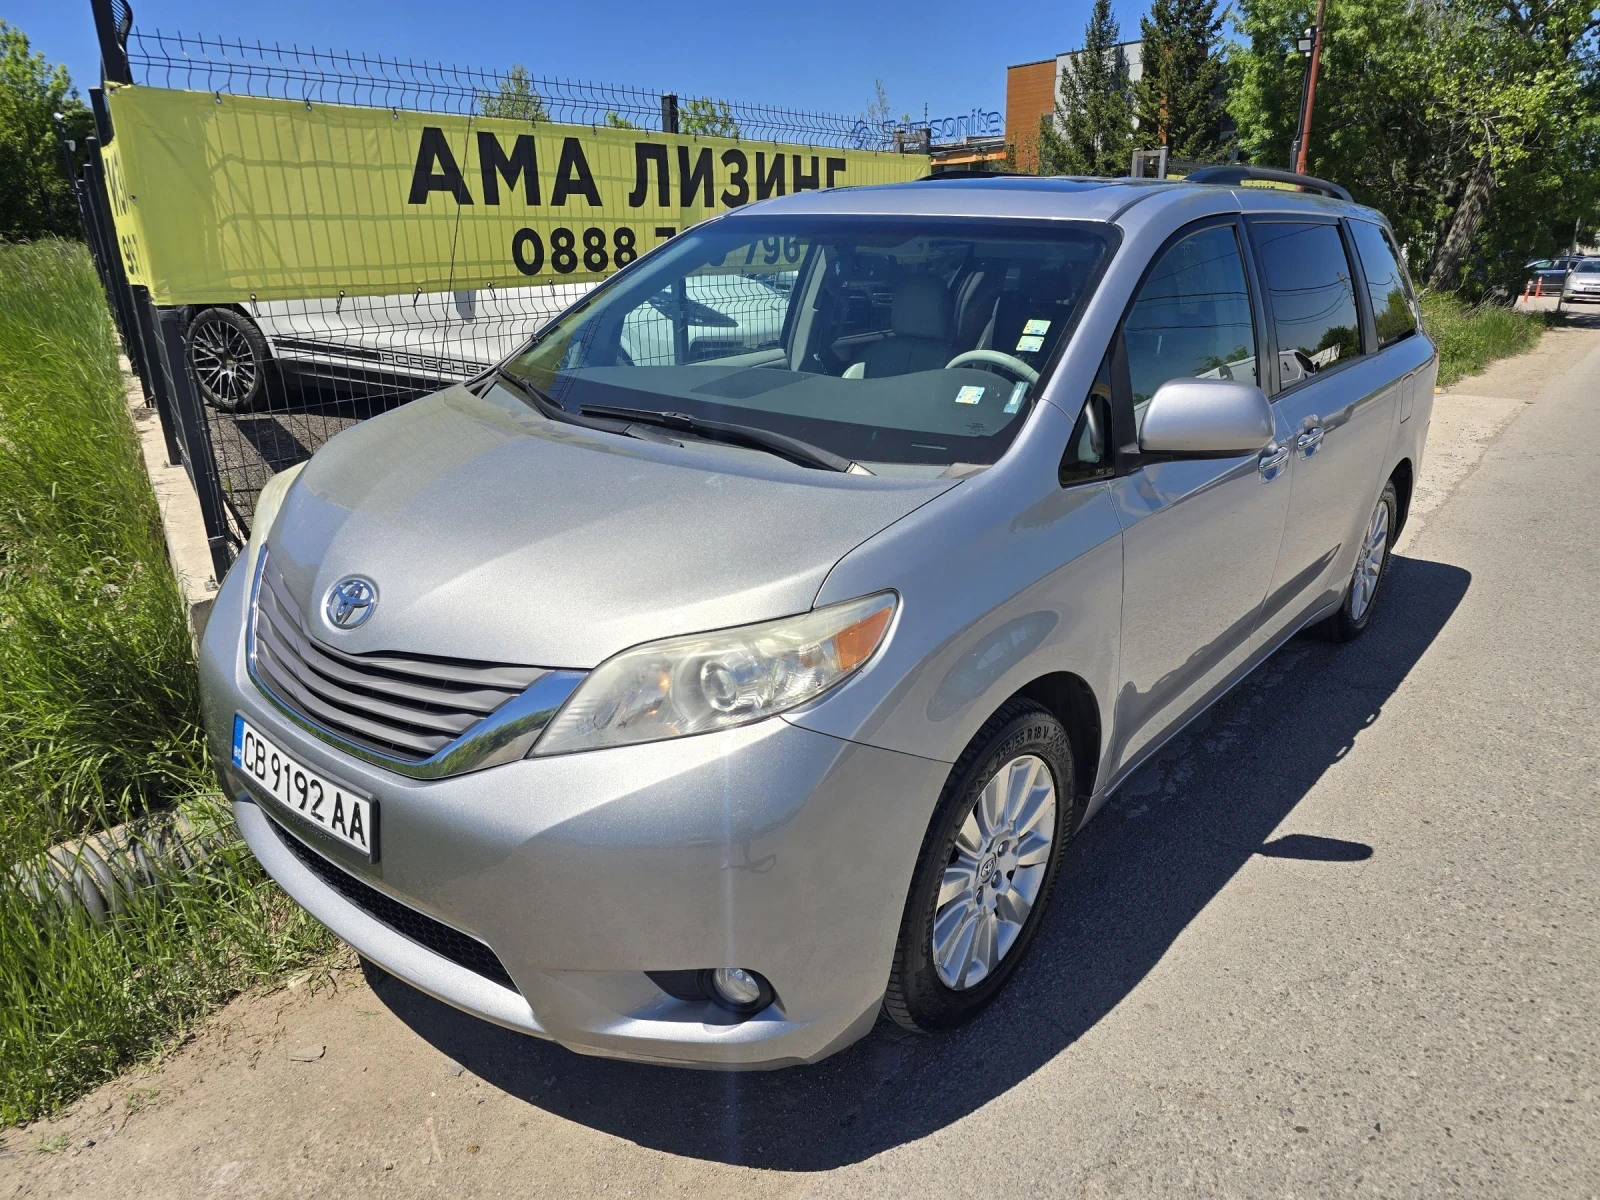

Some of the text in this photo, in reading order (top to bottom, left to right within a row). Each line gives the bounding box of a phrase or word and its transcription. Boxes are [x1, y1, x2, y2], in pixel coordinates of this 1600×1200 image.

[408, 126, 846, 208] АМА ЛИЗИНГ
[511, 226, 638, 276] 0888
[380, 353, 481, 375] PORSCHE
[271, 752, 325, 823] 9192
[331, 791, 367, 847] AA
